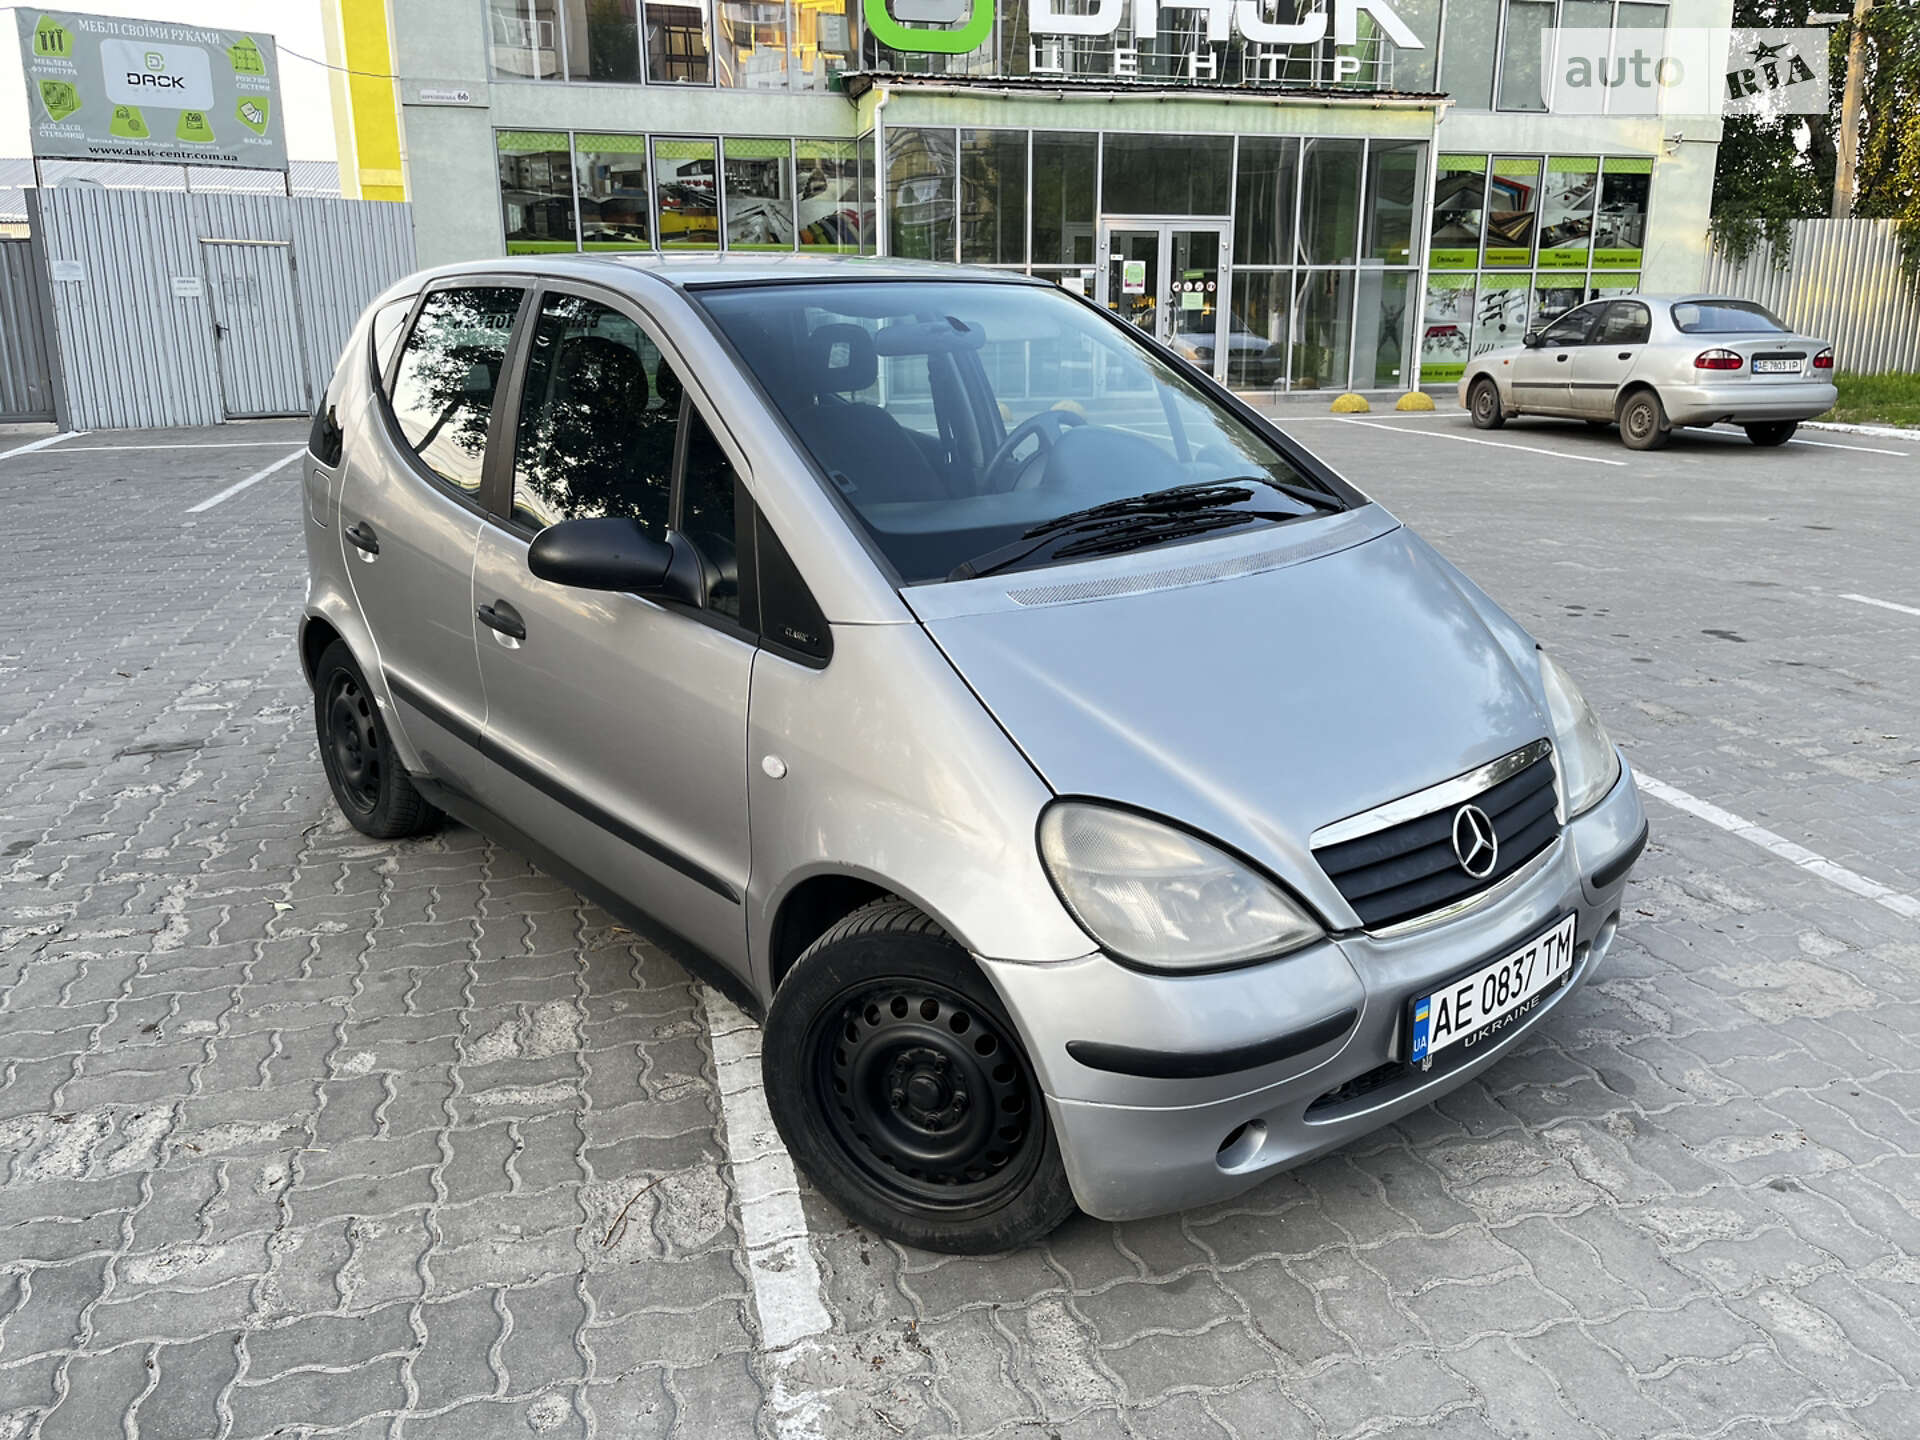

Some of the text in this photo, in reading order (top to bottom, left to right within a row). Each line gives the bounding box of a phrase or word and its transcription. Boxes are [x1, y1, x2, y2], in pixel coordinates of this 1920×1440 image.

[78, 19, 220, 45] МЕБЛІ СВОЇМИ РУКАМИ
[1029, 44, 1361, 83] ЦЕНТР
[127, 72, 185, 89] DACK
[88, 146, 238, 162] www.dask-centr.com.ua
[1431, 923, 1573, 1045] AE 0837 TM
[1464, 994, 1541, 1049] UKRAINE
[1413, 1035, 1427, 1053] UA
